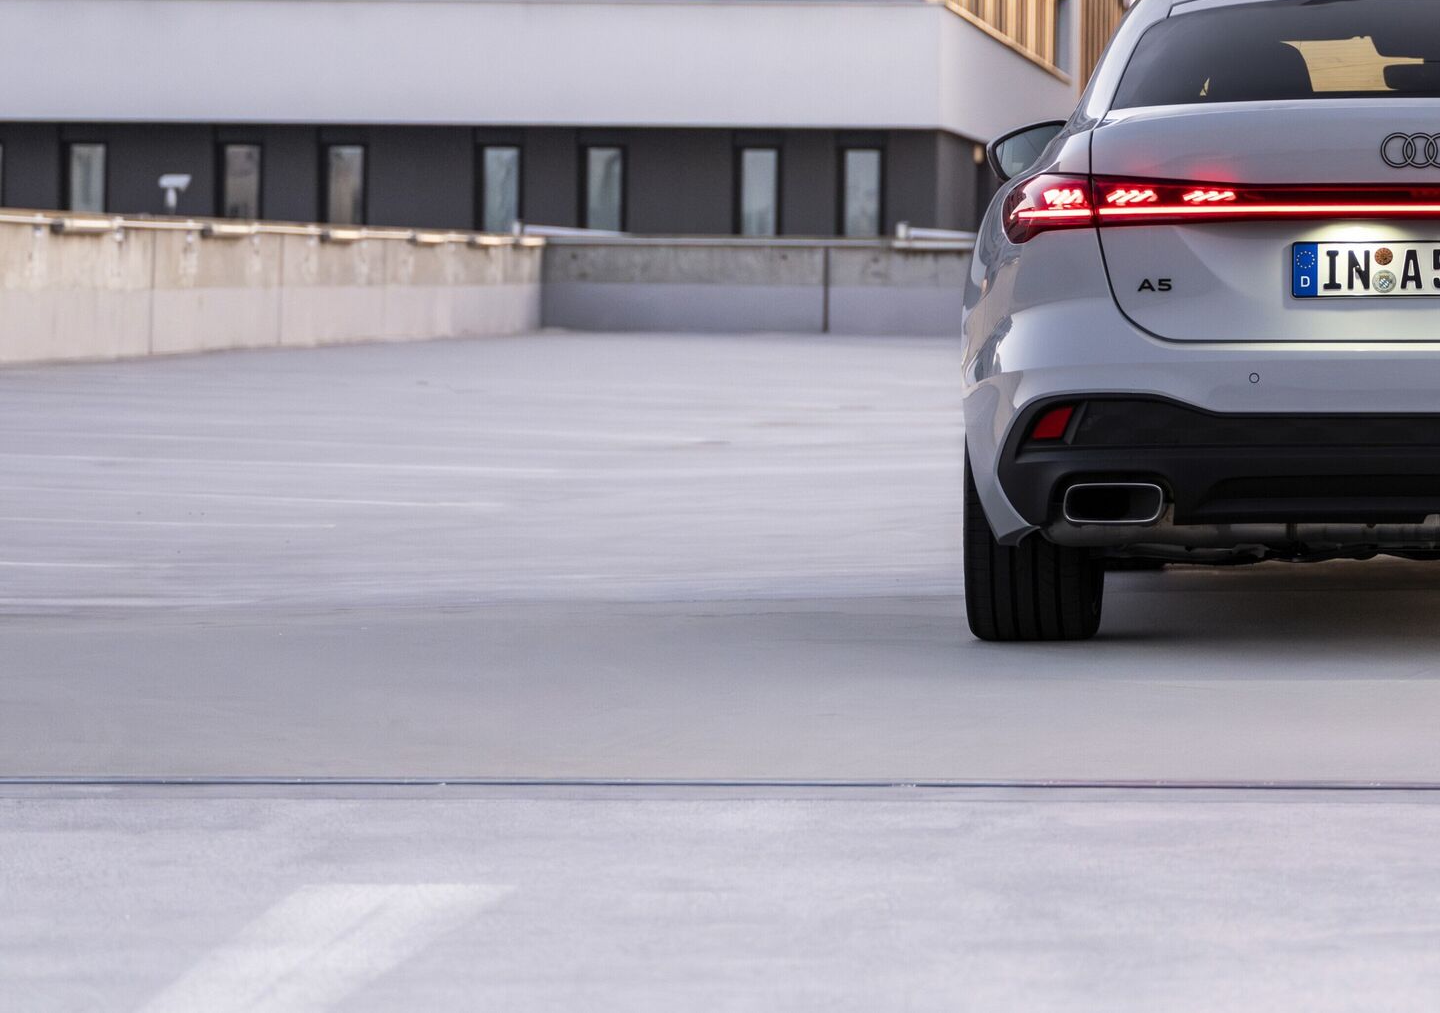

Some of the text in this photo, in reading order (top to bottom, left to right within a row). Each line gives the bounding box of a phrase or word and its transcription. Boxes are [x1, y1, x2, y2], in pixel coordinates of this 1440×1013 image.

[1323, 249, 1371, 290] IN
[1400, 249, 1423, 290] A
[1137, 278, 1172, 292] A5
[1300, 275, 1311, 288] D
